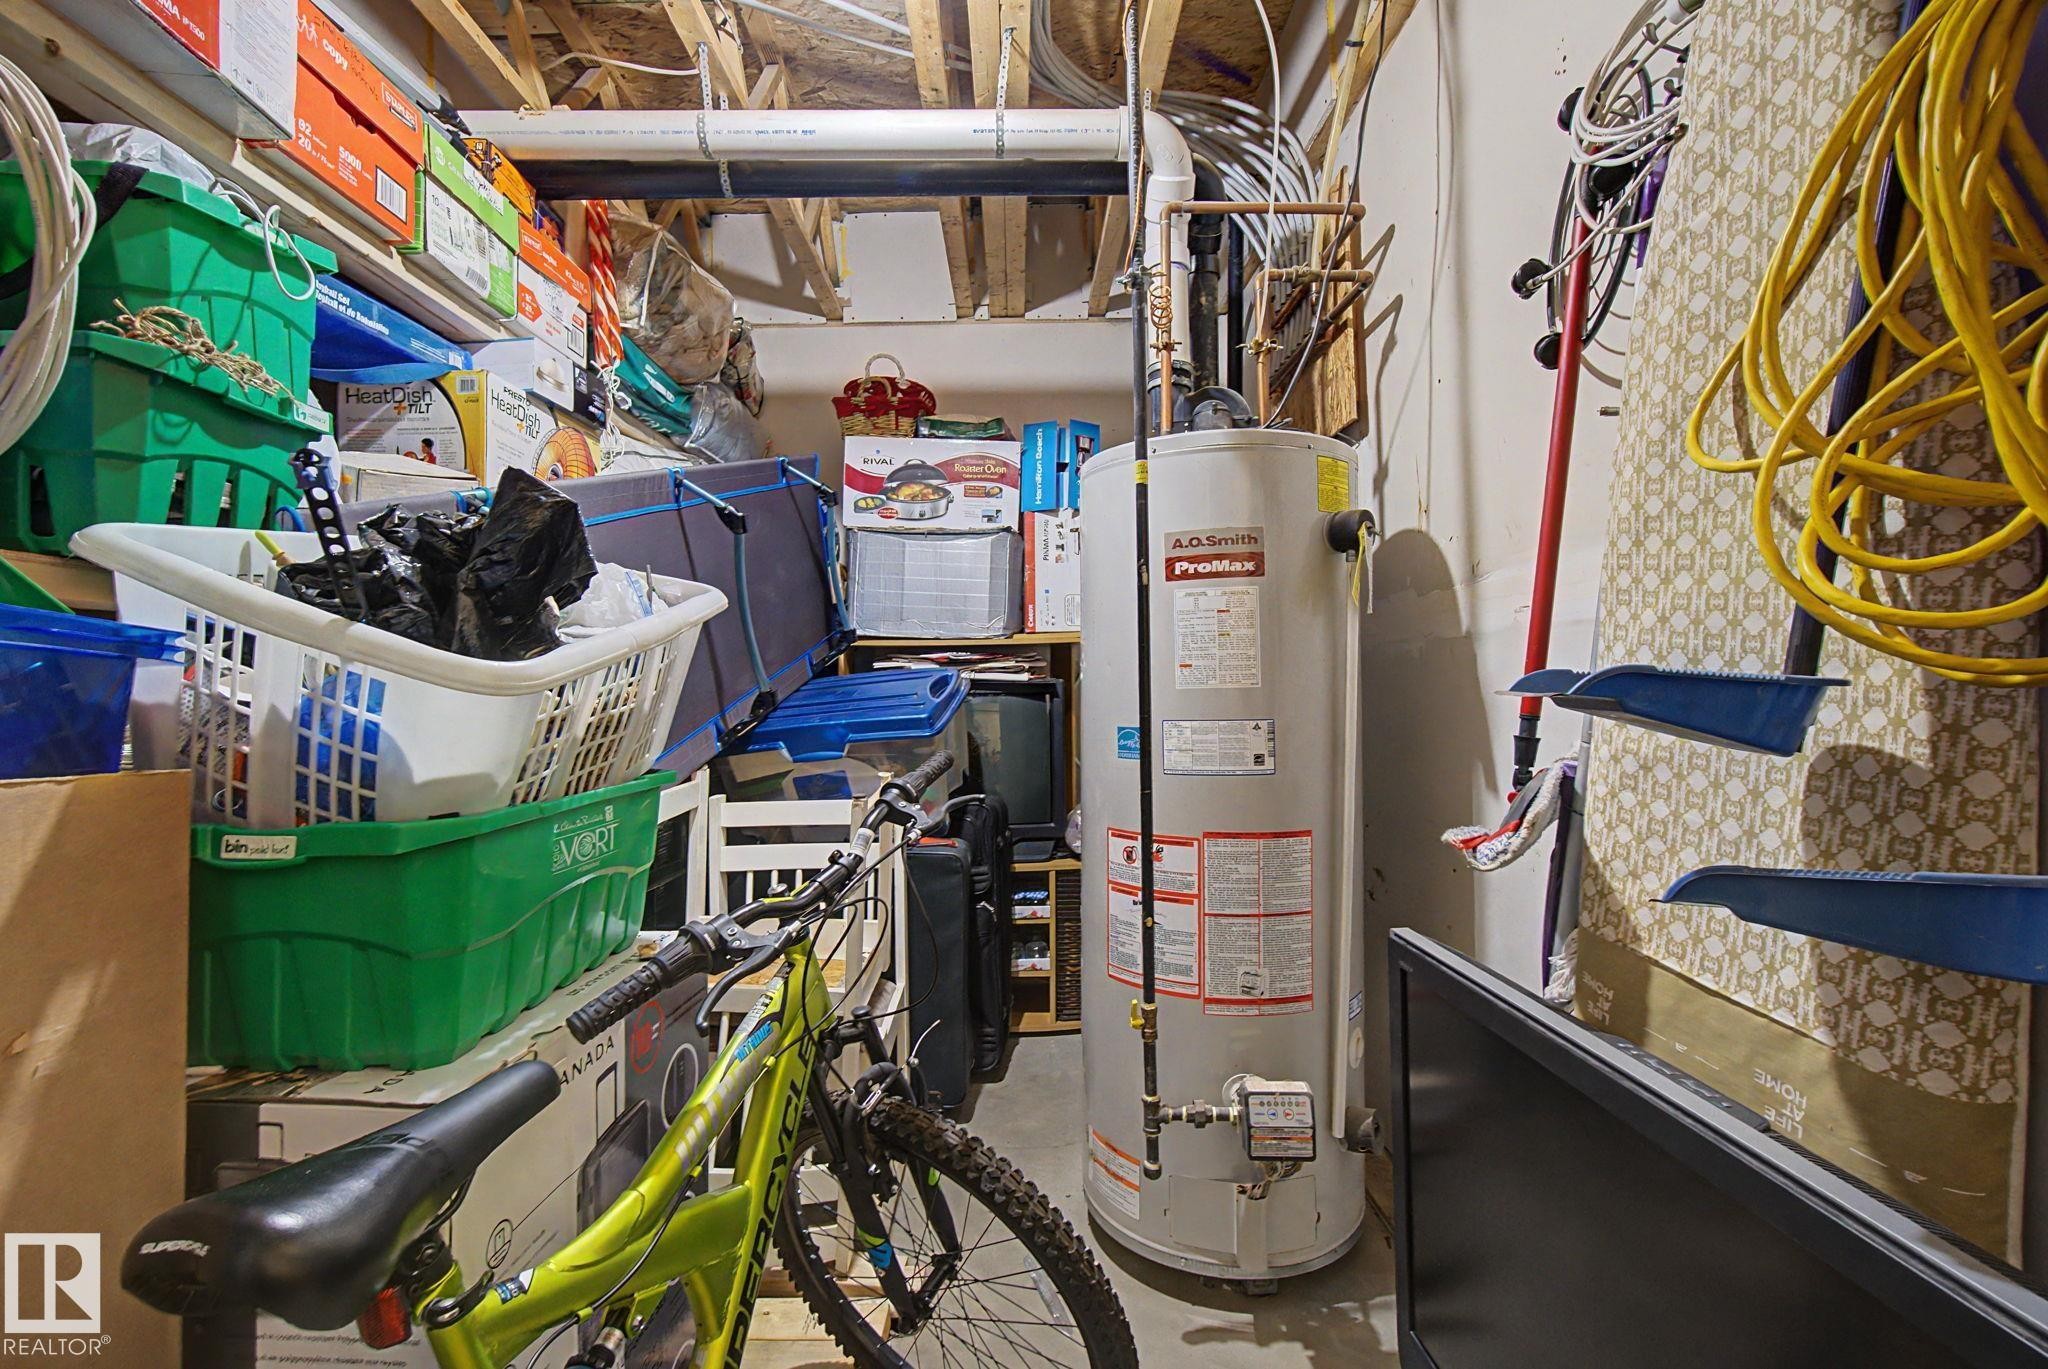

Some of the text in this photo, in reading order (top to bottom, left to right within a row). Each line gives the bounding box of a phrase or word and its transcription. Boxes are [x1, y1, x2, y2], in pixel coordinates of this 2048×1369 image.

[322, 38, 349, 71] copy
[298, 133, 312, 152] 20
[339, 145, 362, 172] 5000
[345, 386, 433, 404] HeatDish
[503, 386, 531, 407] PRESTO
[491, 388, 541, 431] HeatDish
[863, 457, 895, 466] RIVAL
[954, 463, 1007, 474] Roaster Oven
[1035, 428, 1043, 505] Hamilton Beach
[1174, 560, 1256, 575] ProMax
[224, 839, 249, 853] bin
[560, 1035, 614, 1085] ANADA
[1753, 1067, 1807, 1109] HOME
[1763, 1104, 1803, 1139] LIFE
[1782, 1102, 1805, 1121] AT
[723, 1027, 815, 1369] PERCYCLE
